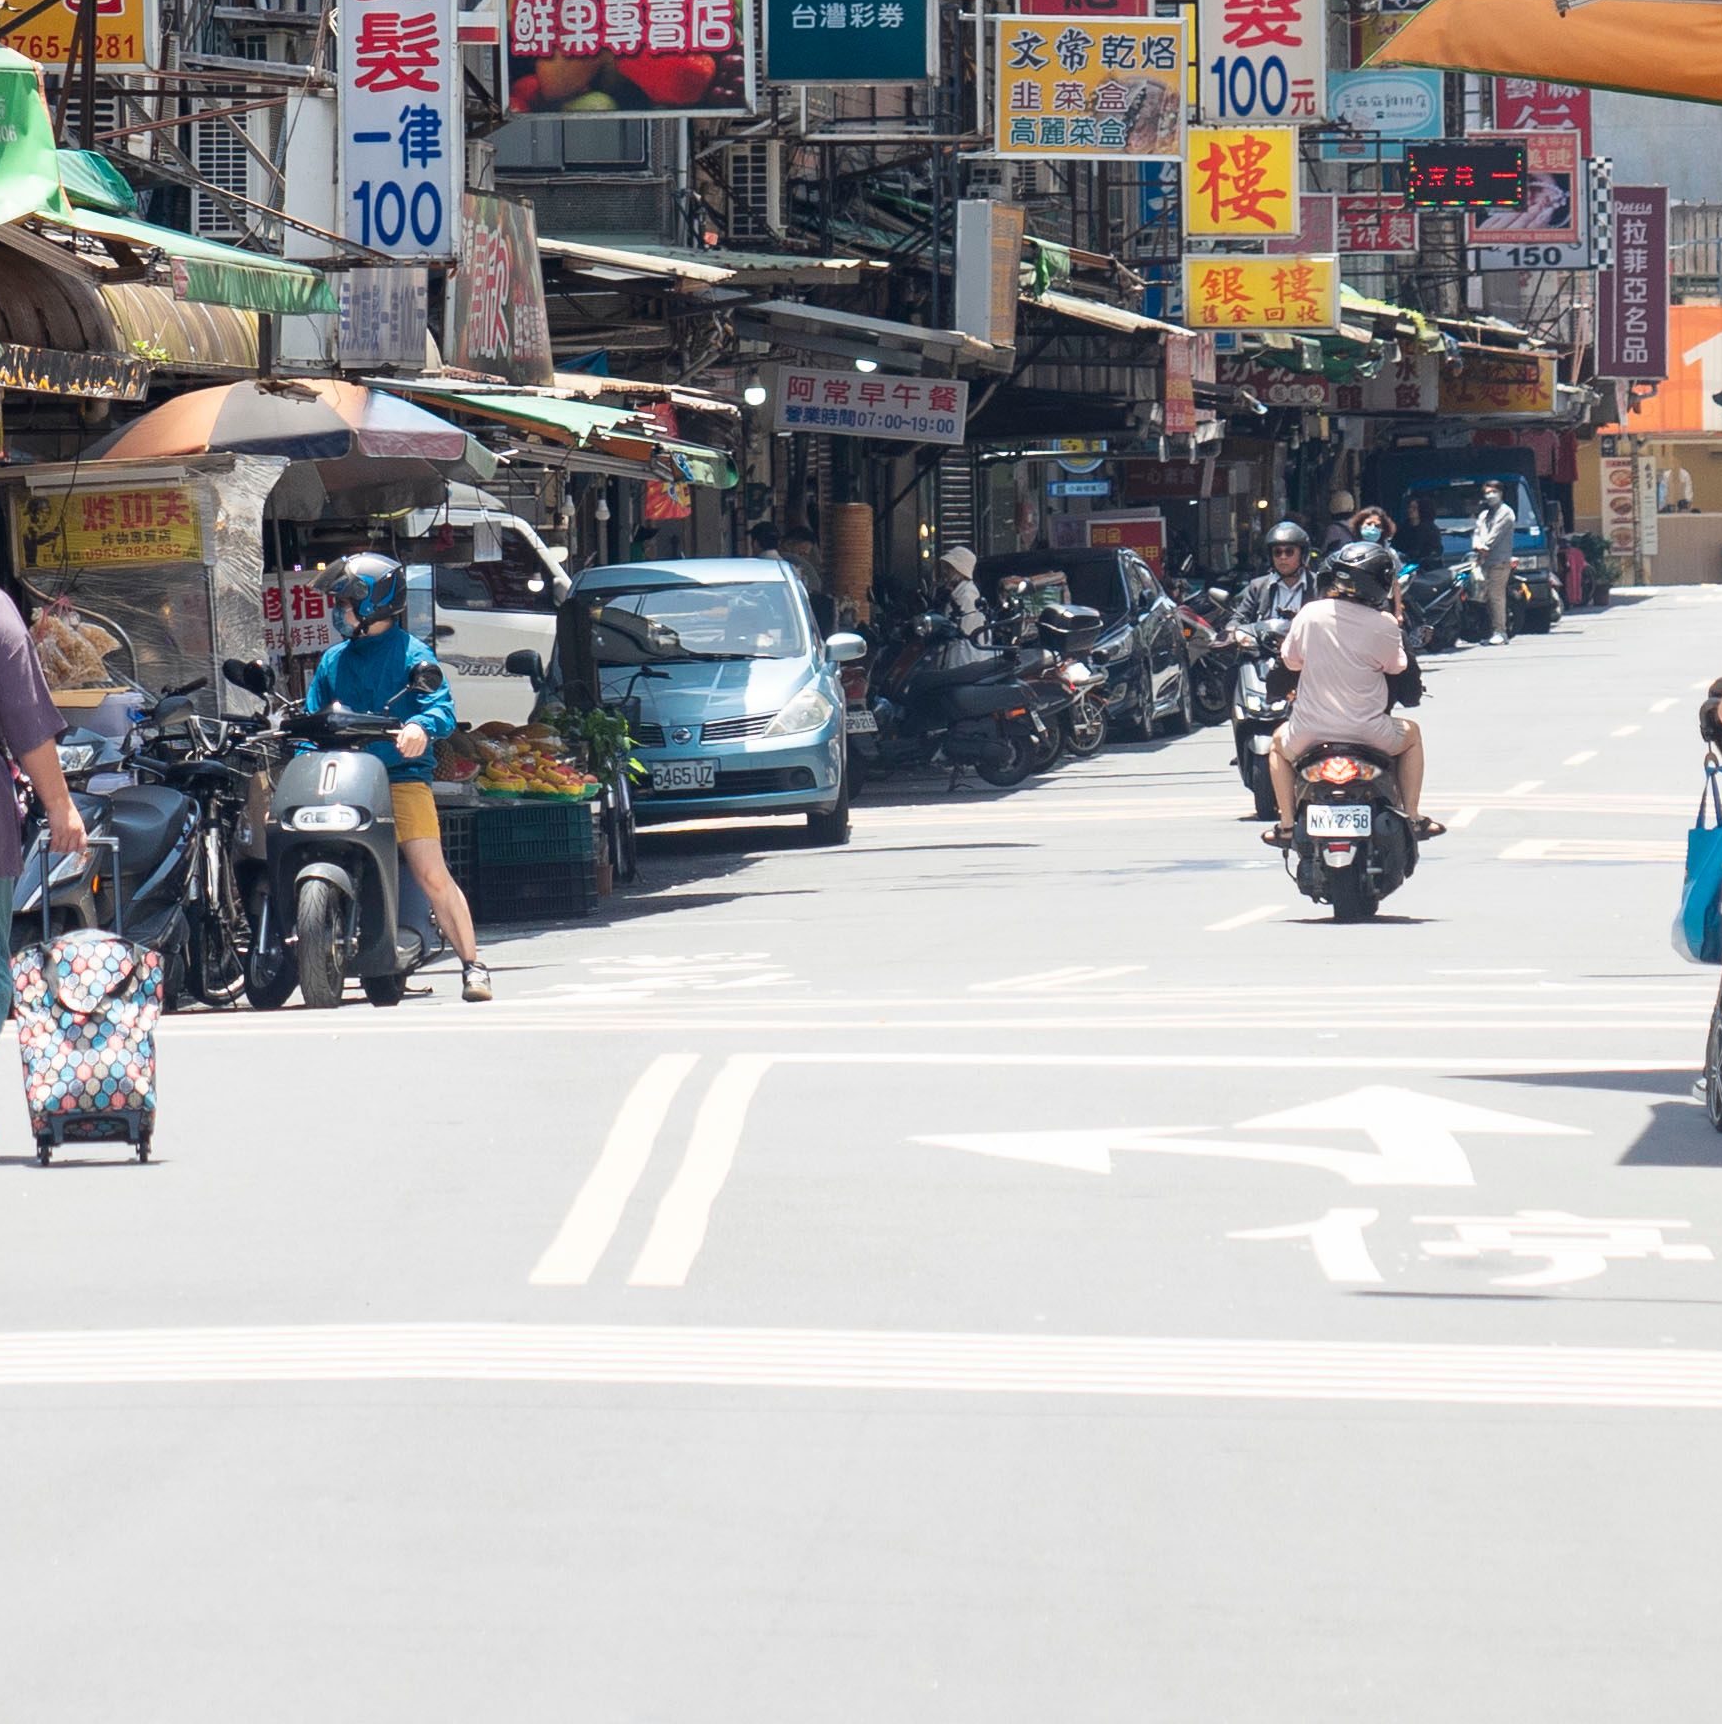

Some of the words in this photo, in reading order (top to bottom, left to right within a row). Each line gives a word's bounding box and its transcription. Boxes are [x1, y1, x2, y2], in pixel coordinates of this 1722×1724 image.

[790, 2, 905, 29] 台灣彩券
[1, 34, 136, 59] 765-281
[1007, 27, 1177, 72] 文常乾烙
[1009, 79, 1129, 113] 韭菜盒
[1210, 54, 1289, 118] 100
[1290, 78, 1317, 117] 元
[353, 104, 443, 168] 一律
[1008, 115, 1129, 148] 高麗菜盒
[1196, 132, 1288, 230] 樓
[353, 180, 443, 247] 100
[1506, 246, 1563, 267] 150
[1199, 260, 1325, 305] 銀樓
[1621, 218, 1650, 365] 拉菲亞名品
[786, 375, 958, 414] 阿常早午餐
[82, 490, 191, 532] 炸功夫
